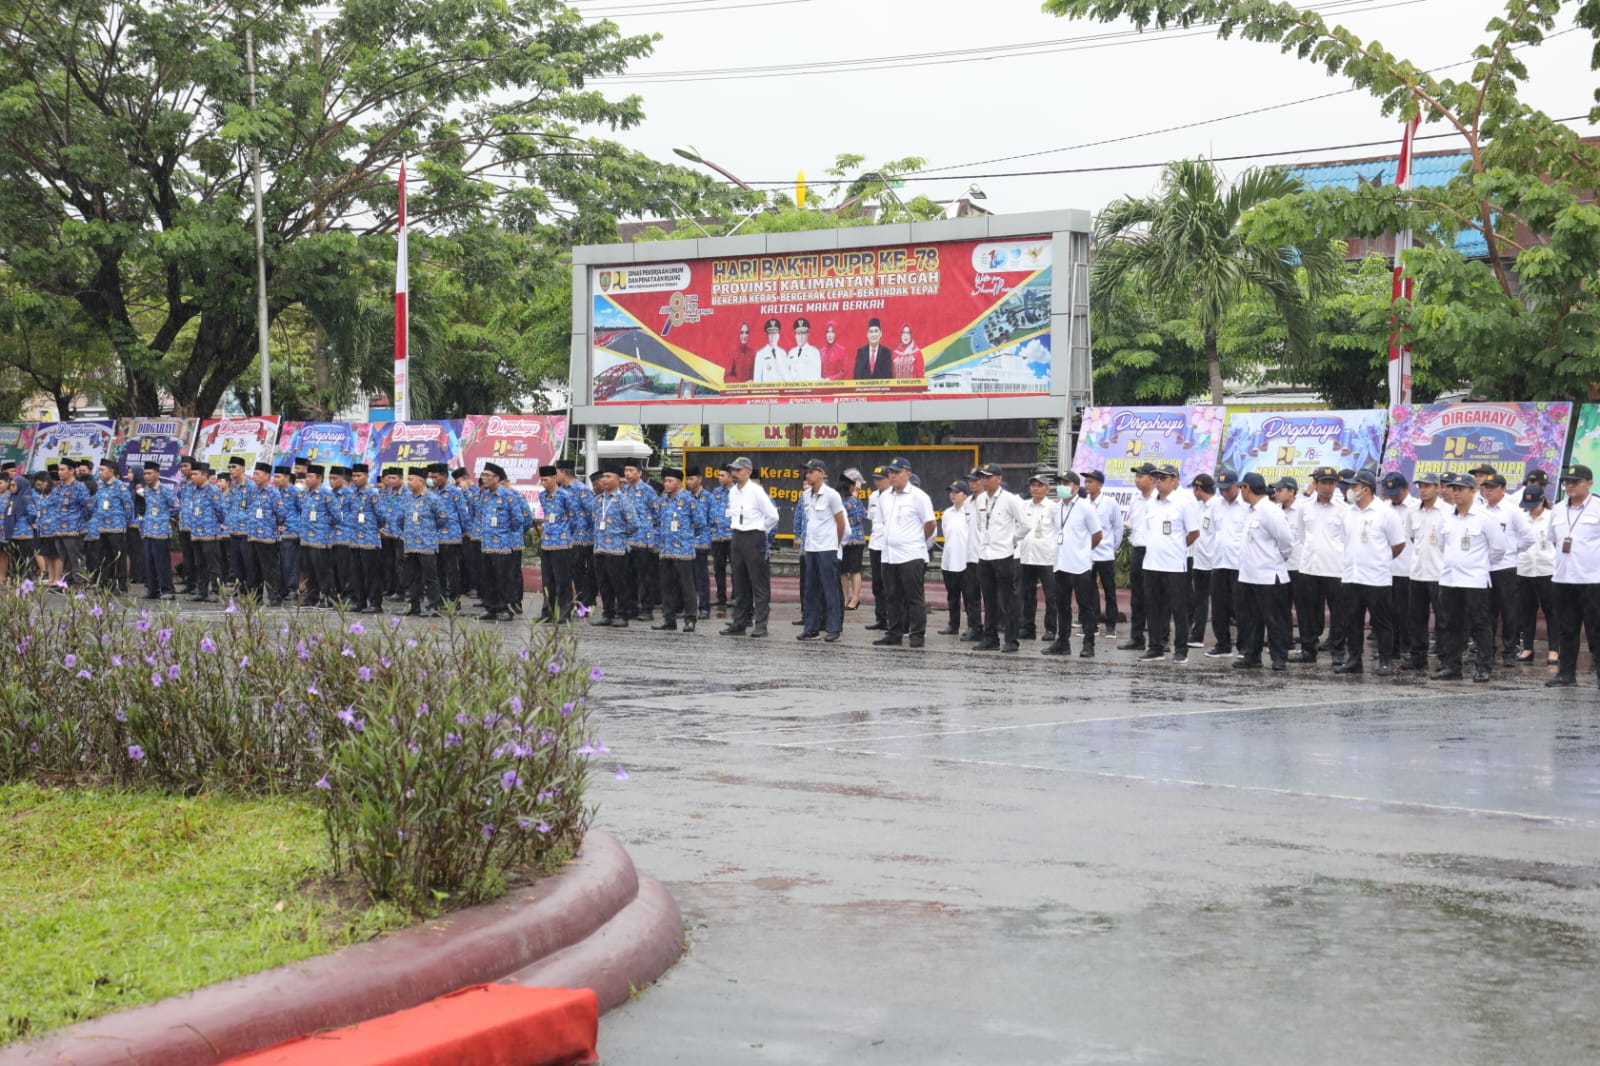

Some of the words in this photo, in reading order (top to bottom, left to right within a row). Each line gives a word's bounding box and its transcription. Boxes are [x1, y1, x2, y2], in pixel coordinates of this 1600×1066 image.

[713, 259, 758, 281] HARI
[761, 256, 818, 279] BAKTI
[821, 252, 875, 275] PUPR
[879, 249, 939, 272] KE-78
[713, 281, 776, 294] PROVINSI
[781, 275, 874, 291] KALIMANTAN
[879, 271, 939, 285] TENGAH
[712, 295, 748, 305] BEKERJA
[827, 286, 908, 299] CEPAT-BERTINDAK
[911, 285, 939, 295] TEPAT
[761, 303, 803, 314] KALTENG
[806, 301, 839, 312] MAKIN
[842, 299, 885, 311] BERKAH
[1114, 411, 1185, 438] Dirgahayu
[1442, 411, 1517, 427] DIRGAHAYU
[137, 423, 178, 434] DIRGAHAYU
[301, 426, 345, 445] Dirgahayu
[814, 425, 839, 439] SOLO
[1262, 416, 1342, 445] Dirgahayu
[760, 467, 800, 478] Keras
[1415, 461, 1447, 473] HARI
